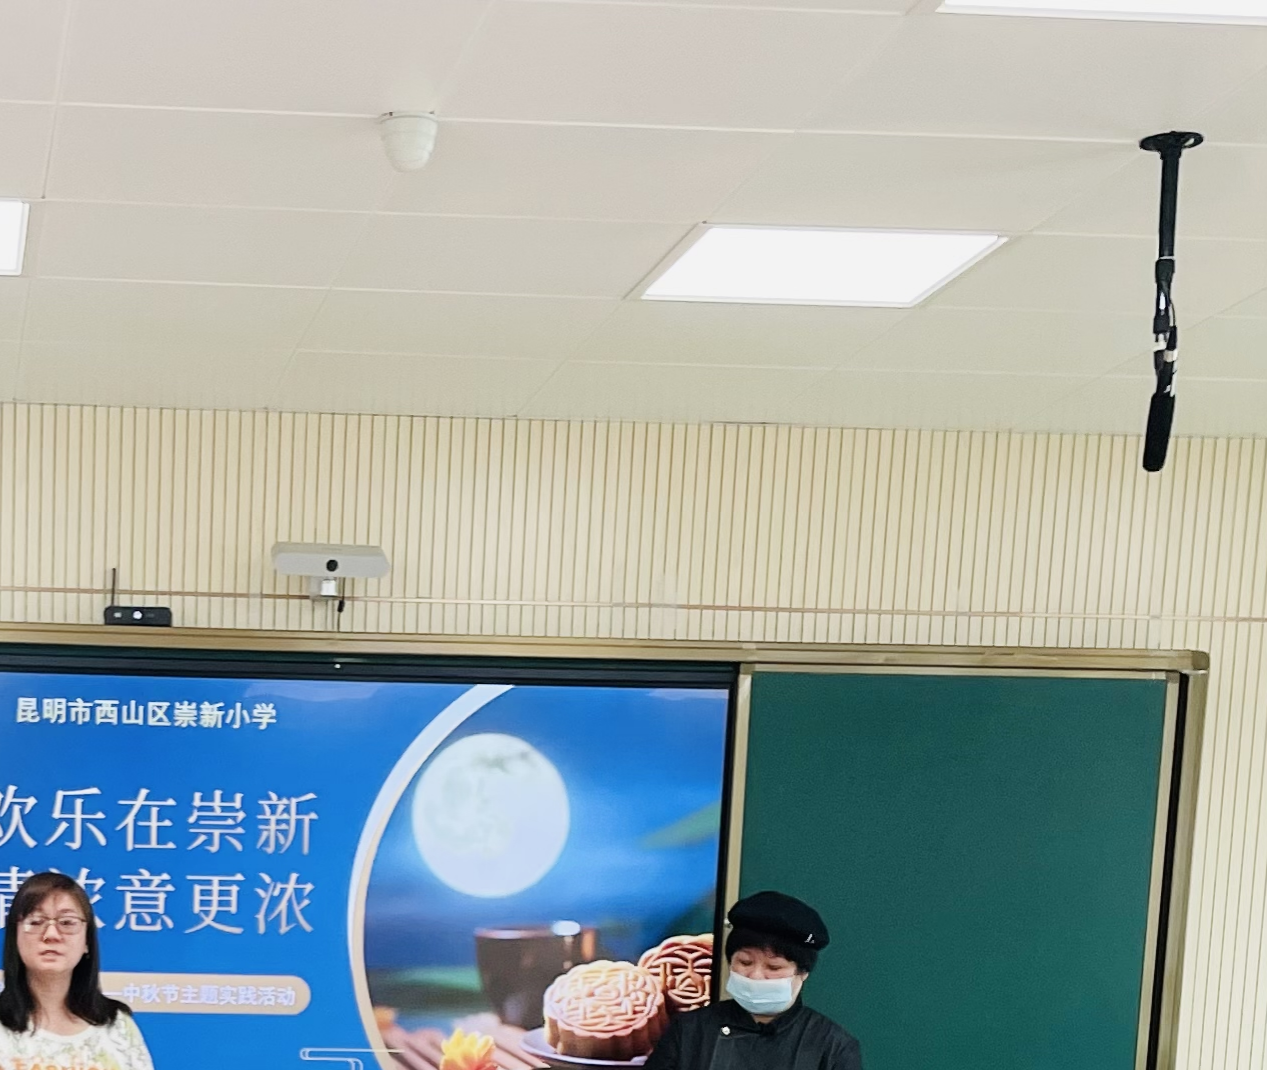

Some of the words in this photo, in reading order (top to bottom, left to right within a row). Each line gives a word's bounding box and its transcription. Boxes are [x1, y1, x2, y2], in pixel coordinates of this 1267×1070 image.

[16, 697, 277, 730] 昆明市西山区崇新小学
